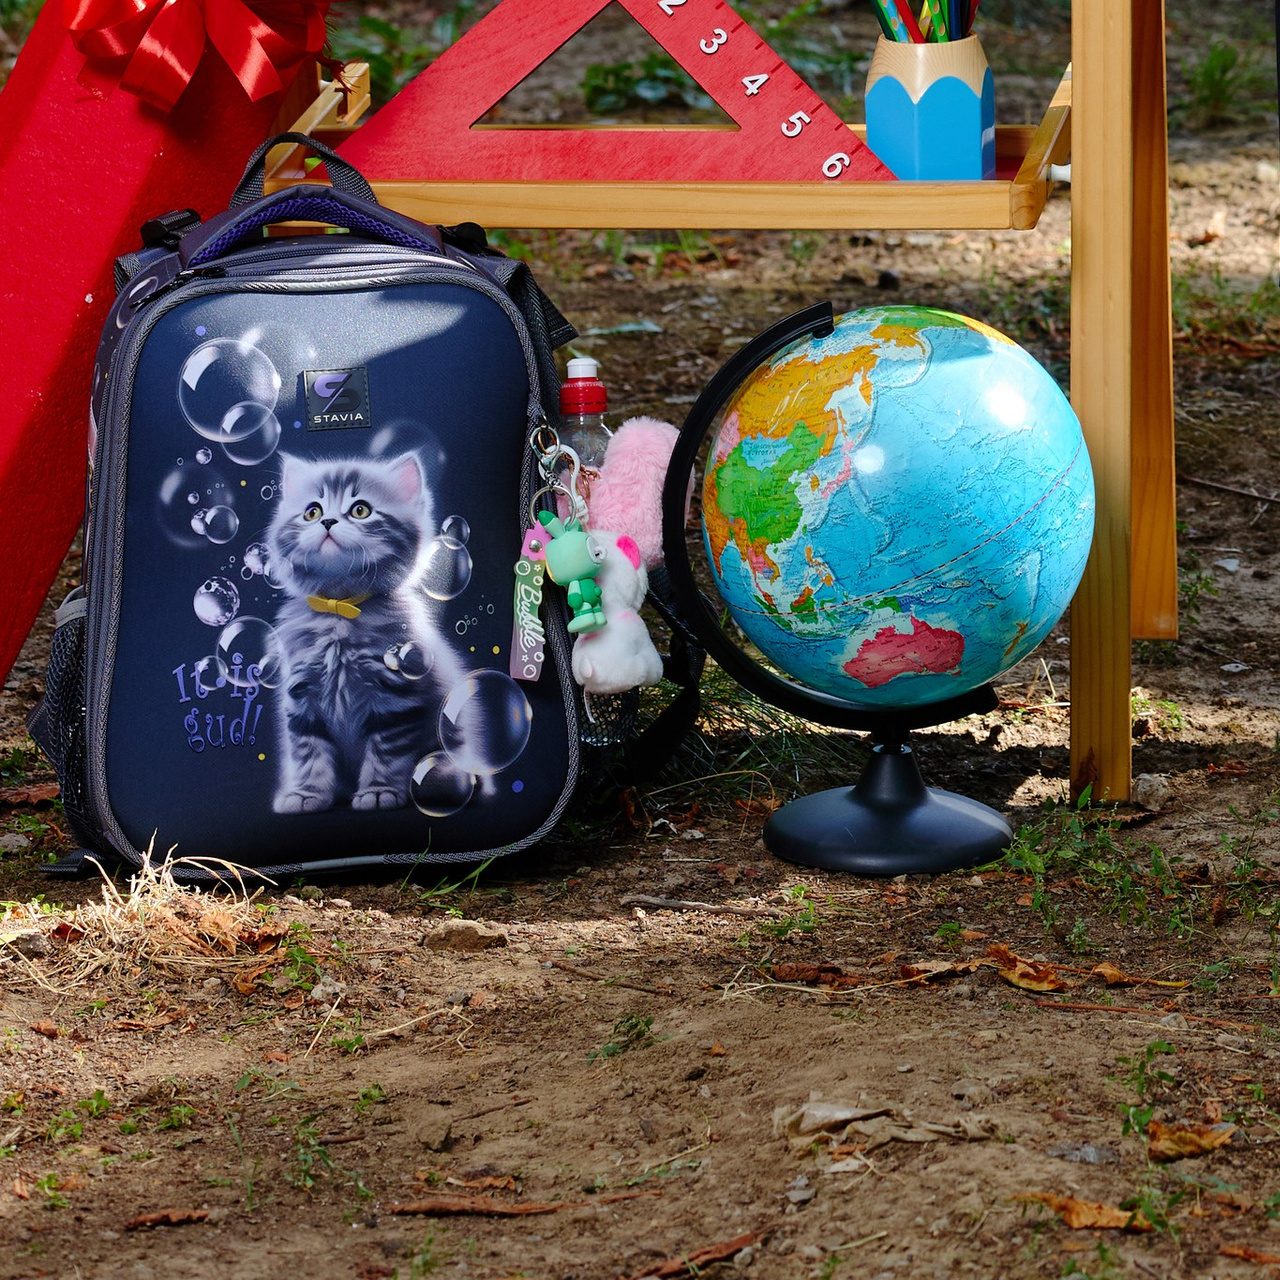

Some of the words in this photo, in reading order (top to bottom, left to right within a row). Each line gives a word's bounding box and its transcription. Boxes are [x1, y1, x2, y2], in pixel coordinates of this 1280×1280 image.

[699, 28, 728, 55] 3
[740, 72, 770, 97] 4
[781, 110, 811, 138] 5
[821, 151, 851, 179] 6
[312, 412, 364, 425] STAVIA
[520, 582, 546, 649] Bubble
[172, 658, 209, 704] It
[229, 652, 262, 700] is
[182, 691, 264, 753] gud!
